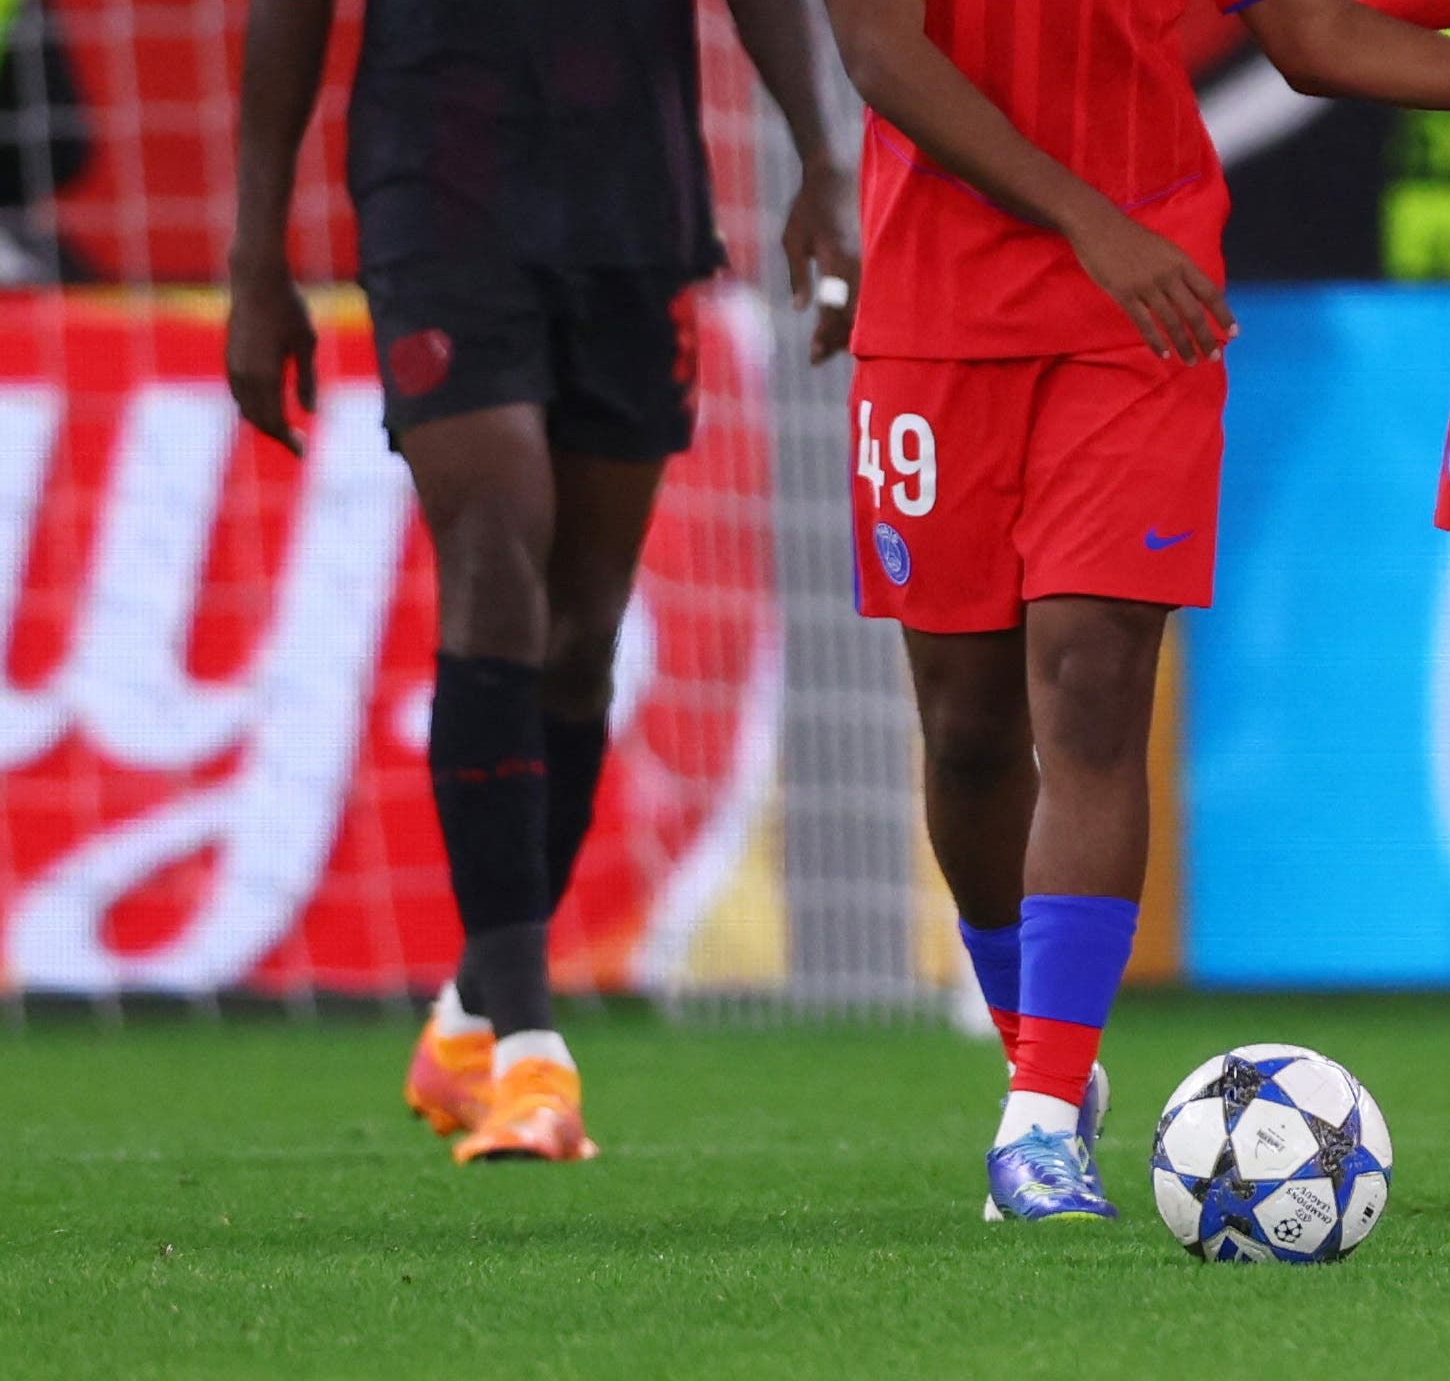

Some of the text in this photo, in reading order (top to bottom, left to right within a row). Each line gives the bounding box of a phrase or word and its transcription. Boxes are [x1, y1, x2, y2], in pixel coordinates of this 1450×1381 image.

[857, 400, 937, 517] 49
[1286, 1187, 1333, 1224] CHAMPIONS
[1301, 1187, 1331, 1212] LEAGUE
